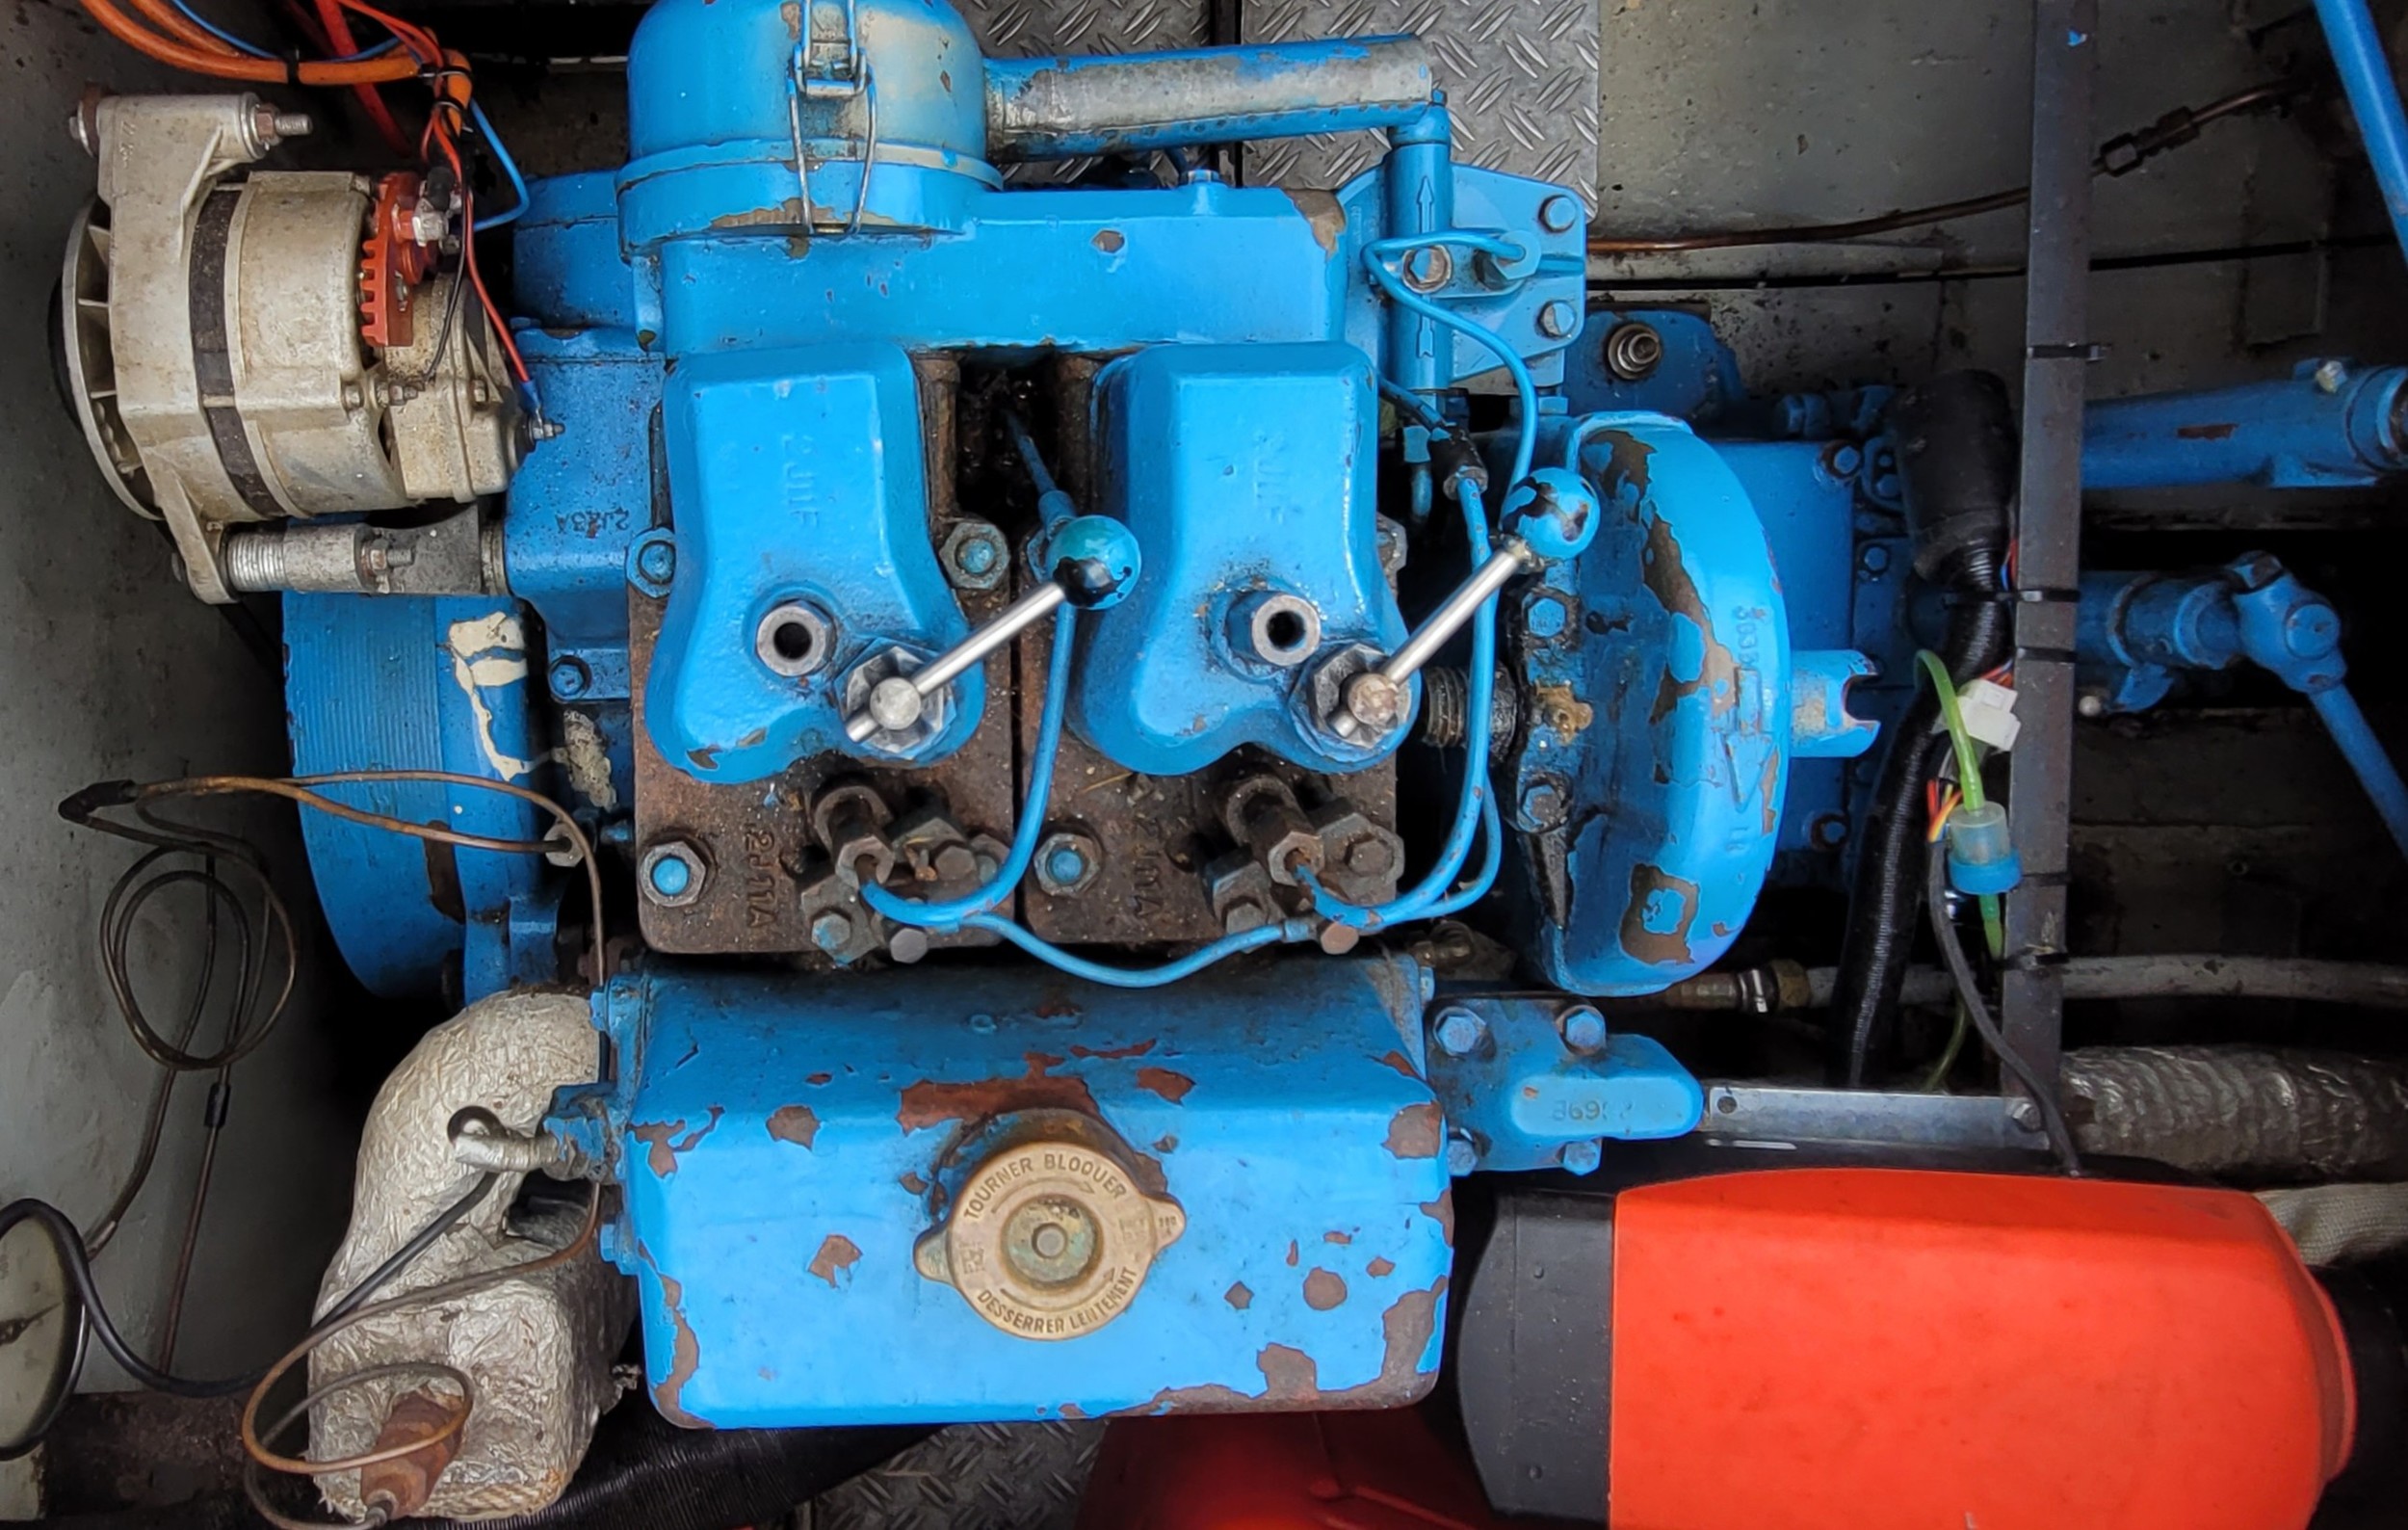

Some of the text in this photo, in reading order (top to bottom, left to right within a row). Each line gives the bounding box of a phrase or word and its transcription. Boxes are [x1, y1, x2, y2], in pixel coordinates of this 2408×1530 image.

[746, 830, 776, 928] 2J11A
[964, 1153, 1127, 1222] TOURNER BLOQUER
[977, 1266, 1138, 1334] DESSERRER LENTEMENT
